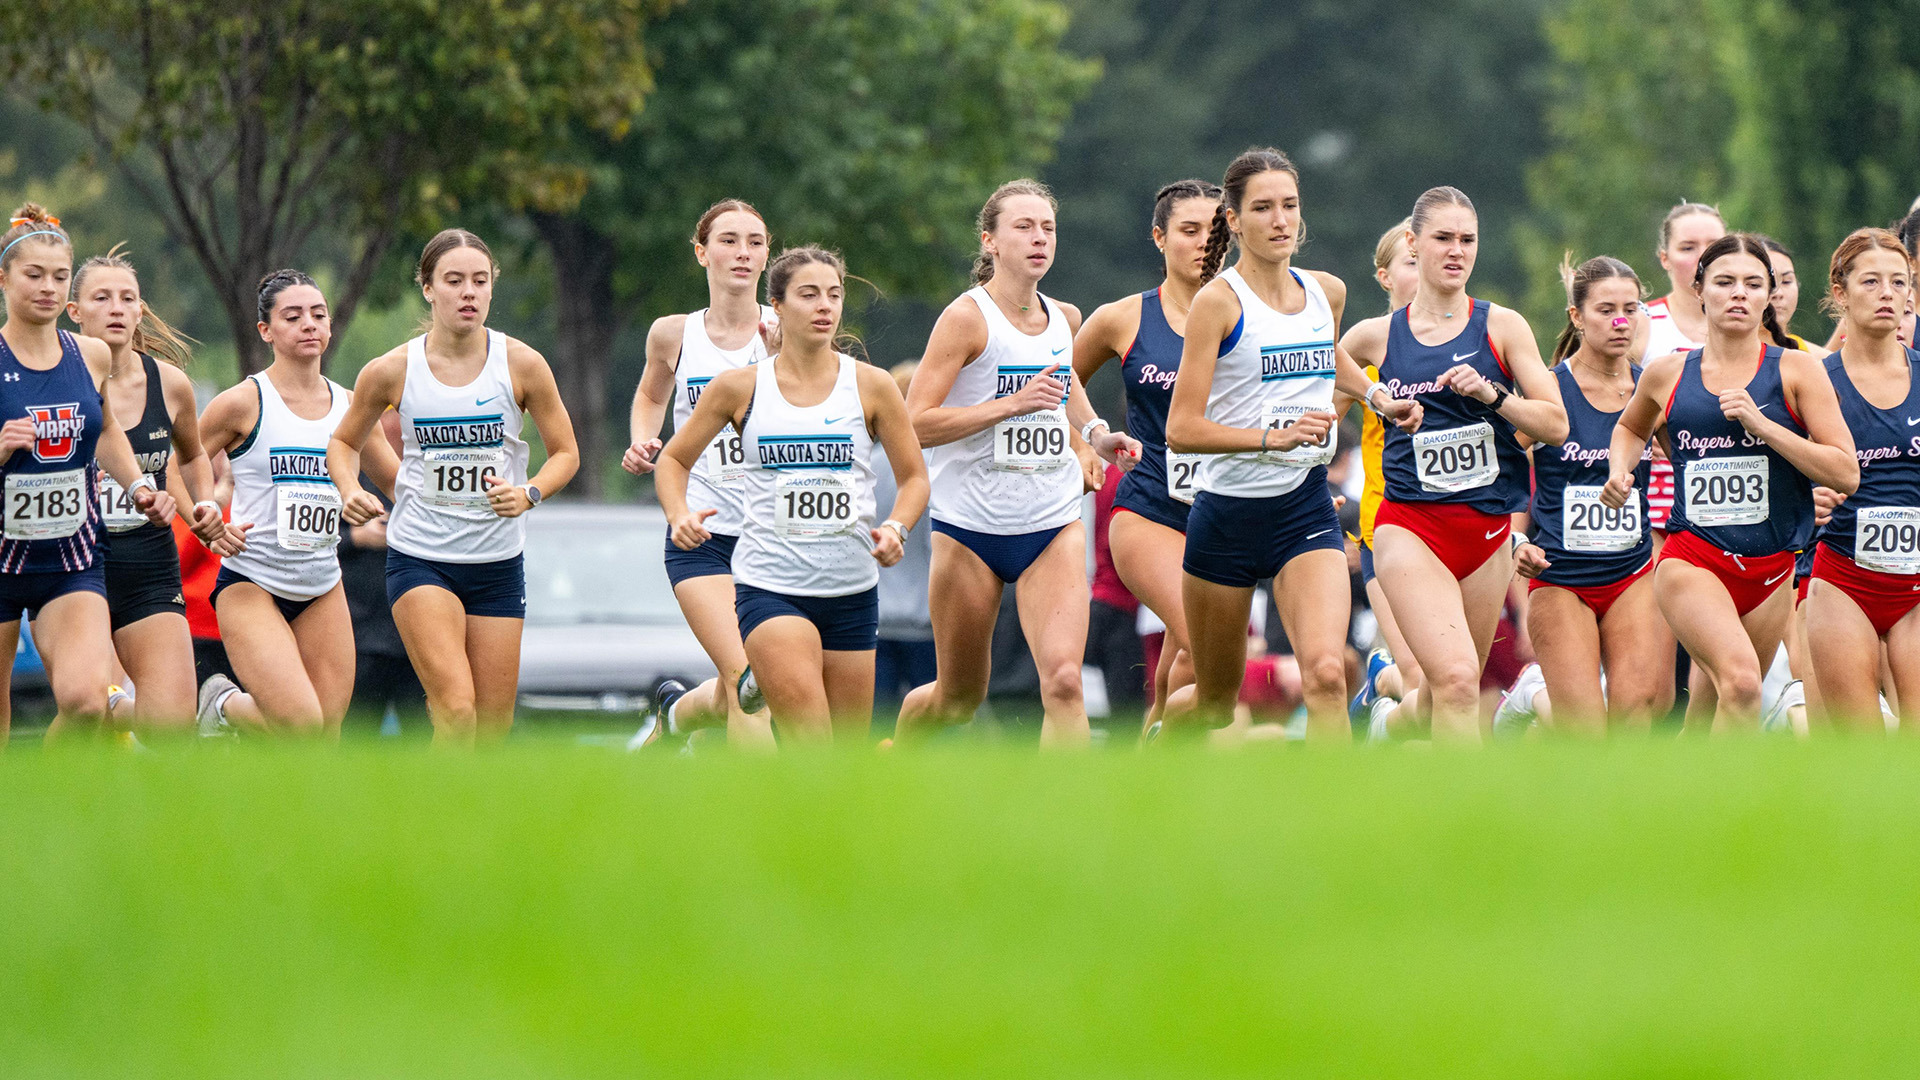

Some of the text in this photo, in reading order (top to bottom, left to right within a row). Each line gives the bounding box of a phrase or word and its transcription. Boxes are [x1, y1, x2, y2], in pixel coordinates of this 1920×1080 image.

[1261, 350, 1310, 375] DAKOTA
[1138, 363, 1178, 390] Rog
[32, 418, 82, 439] MARY
[414, 421, 506, 444] DAKOTA STATE
[1002, 427, 1065, 456] 1809
[1423, 426, 1487, 445] DAKOTATIMING
[433, 452, 497, 461] DAKOTATIMING
[713, 436, 745, 467] 18
[758, 443, 856, 464] DAKOTA STATE
[1560, 441, 1610, 468] Roger
[1677, 429, 1735, 457] Rogers
[1856, 445, 1902, 468] ogers
[269, 455, 320, 475] DAKOTA
[1421, 439, 1489, 477] 2091
[1693, 460, 1760, 472] DAKOTATIMING
[16, 474, 79, 488] DAKOTATIMING
[1690, 474, 1764, 506] 2093
[13, 487, 81, 520] 2183
[783, 491, 851, 520] 1808
[1570, 503, 1637, 531] 2095
[285, 503, 337, 535] 1806
